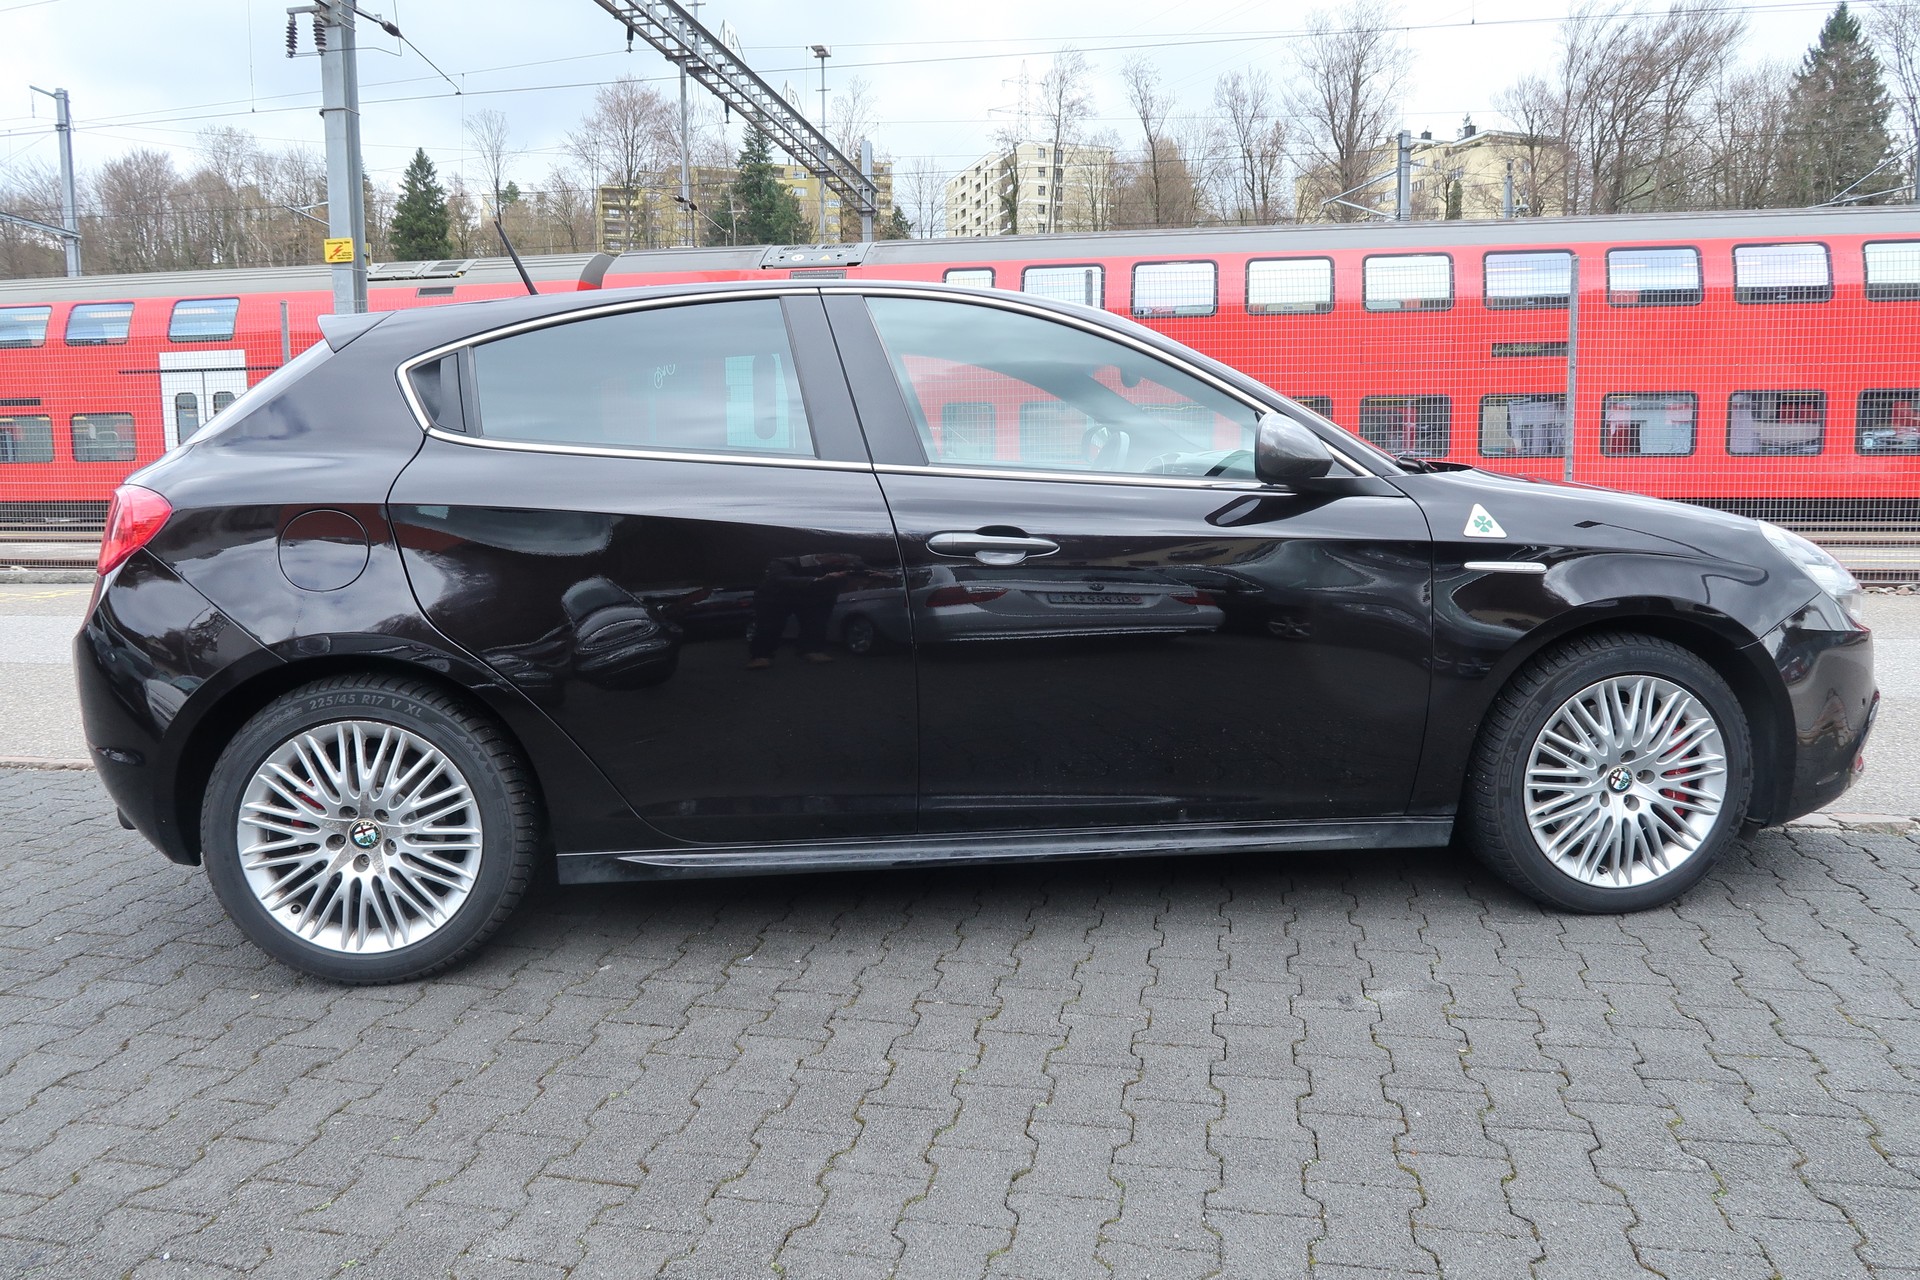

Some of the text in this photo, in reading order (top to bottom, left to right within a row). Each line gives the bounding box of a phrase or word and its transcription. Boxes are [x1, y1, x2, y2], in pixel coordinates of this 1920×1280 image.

[309, 694, 423, 718] 225/45 R17 V XL
